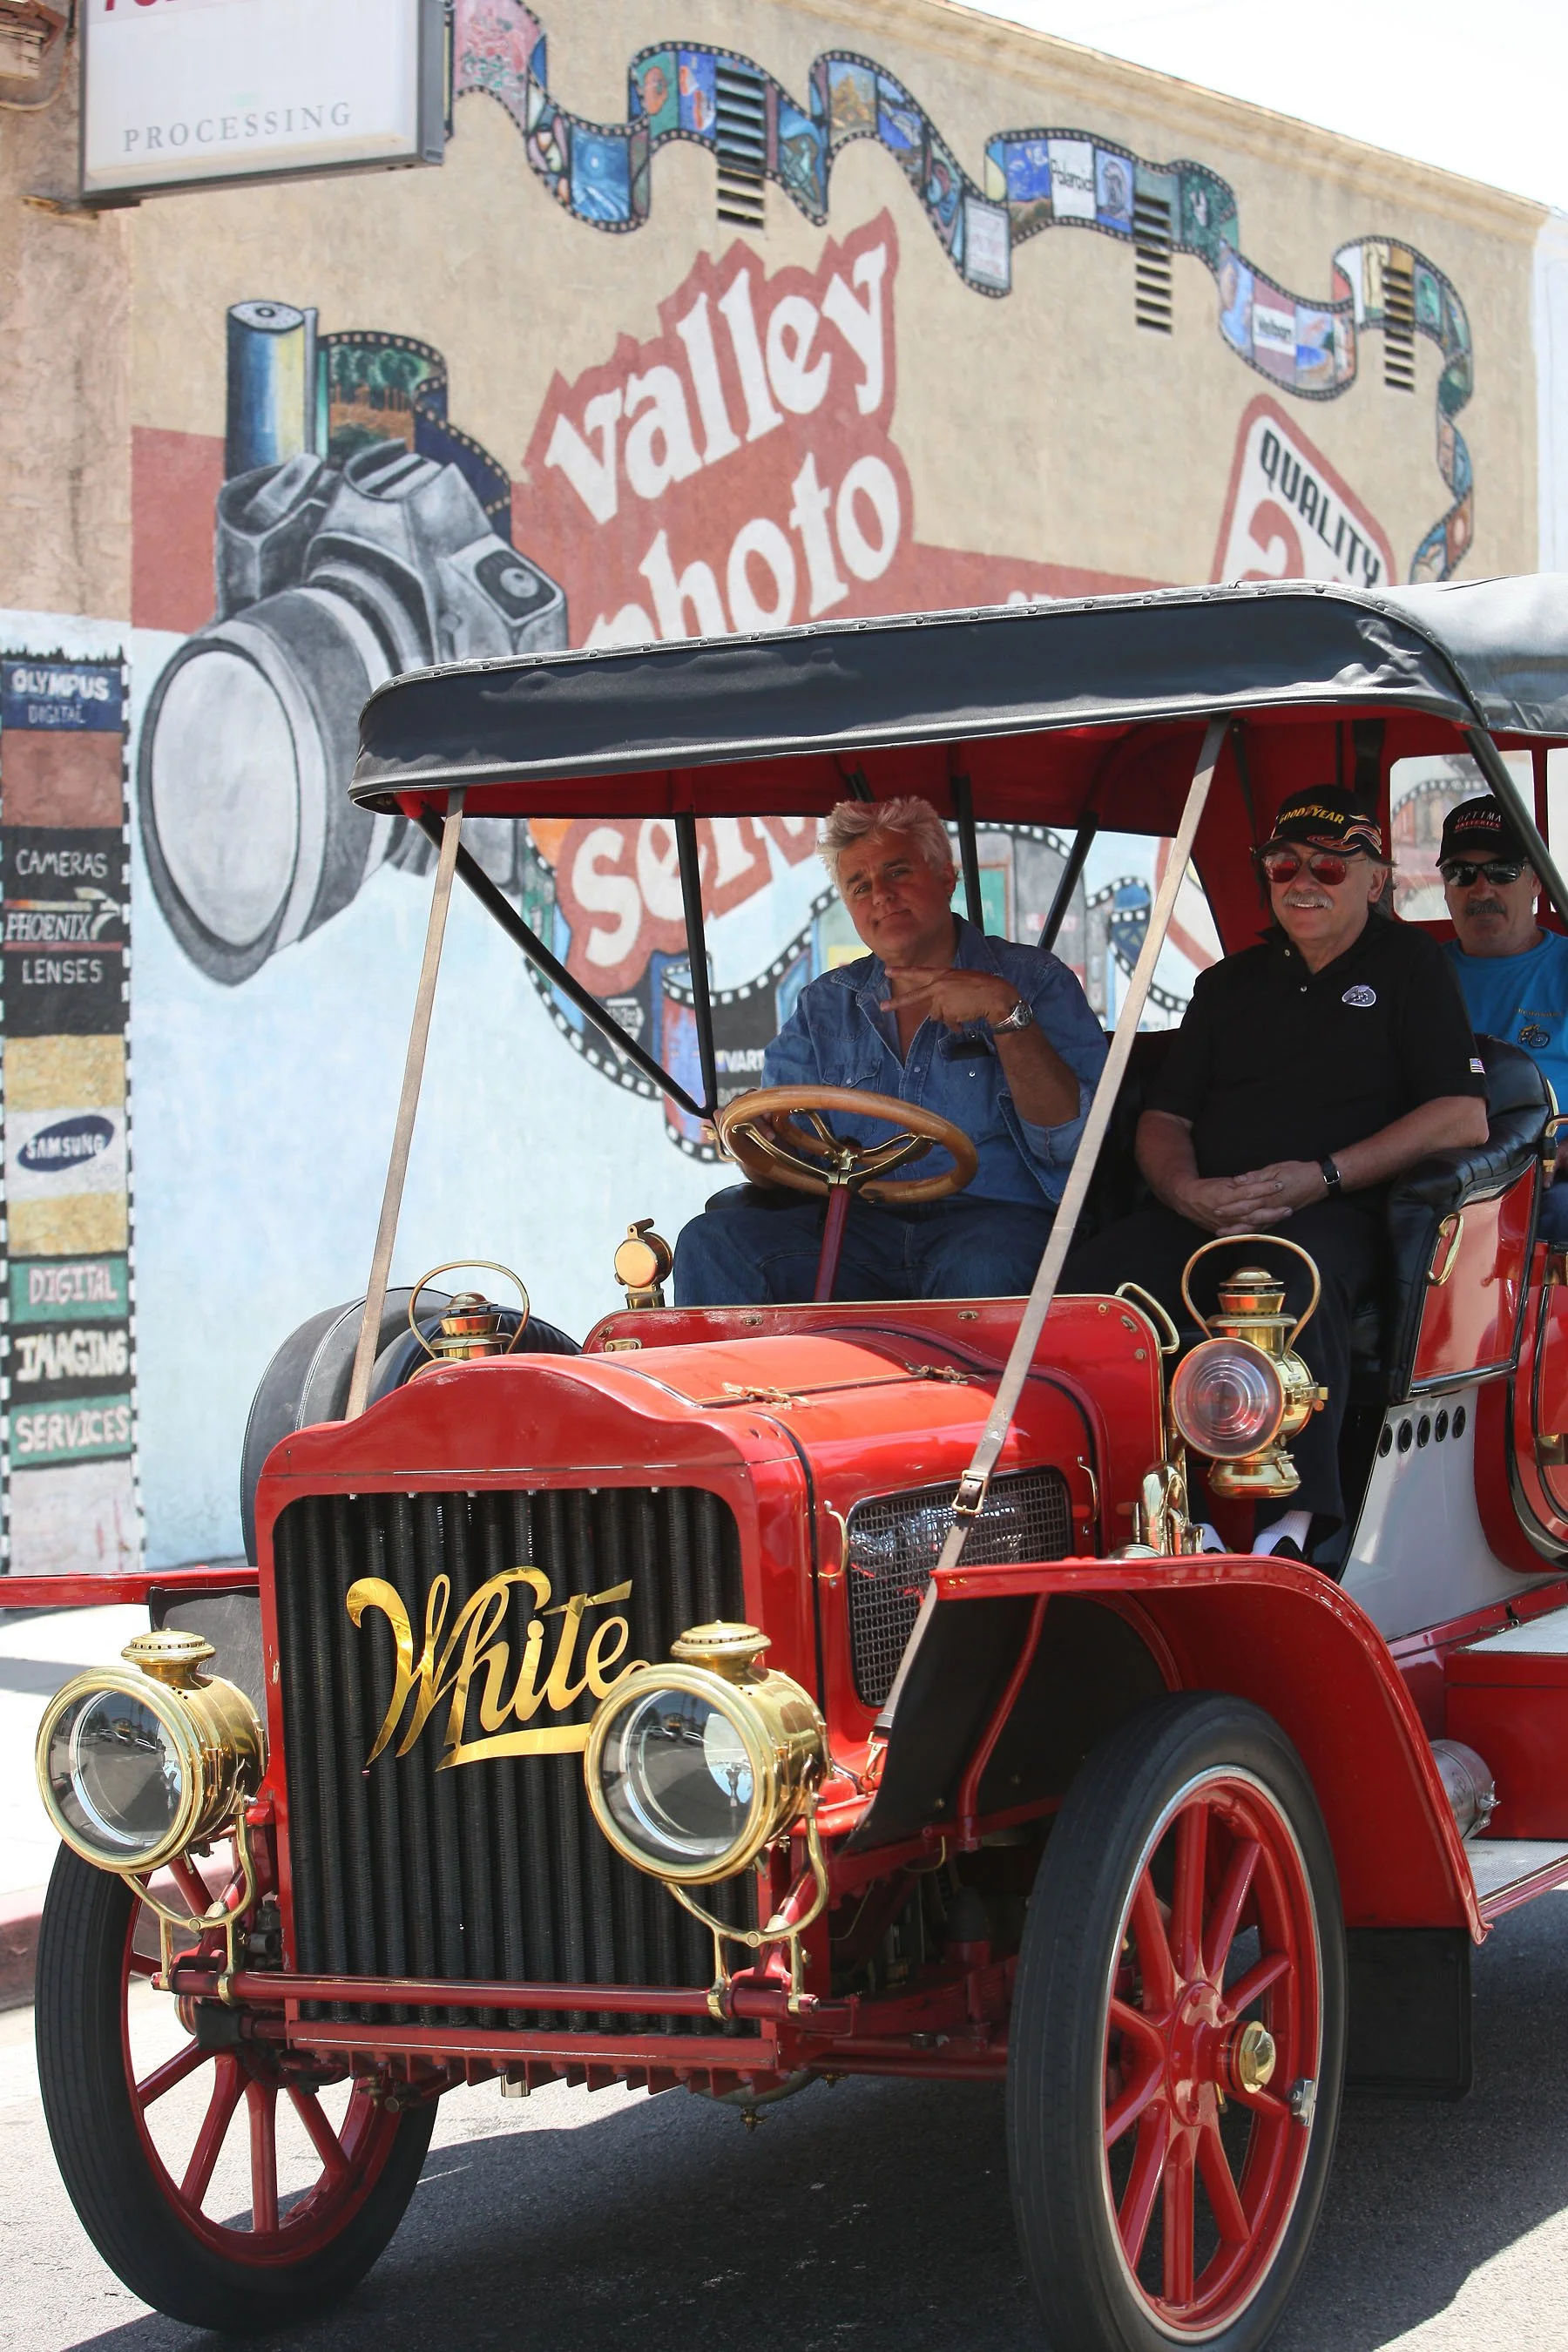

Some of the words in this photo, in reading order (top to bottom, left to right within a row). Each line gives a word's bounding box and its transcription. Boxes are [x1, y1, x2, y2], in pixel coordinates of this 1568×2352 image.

[123, 100, 352, 152] PROCESSING
[544, 242, 887, 525] valley
[1260, 429, 1382, 589] QUALITY
[11, 667, 110, 701] OLYMPUS
[28, 703, 85, 725] DIGITAL
[1457, 810, 1502, 823] OPTIMA
[16, 848, 108, 879] CAMERAS
[4, 912, 93, 942] PHOENIX
[22, 958, 104, 985] LENSES
[25, 1132, 105, 1161] SAMSUNG
[28, 1264, 118, 1306] DIGITAL
[15, 1328, 128, 1383] IMAGING
[15, 1403, 131, 1454] SERVICES
[346, 1565, 650, 1768] White
